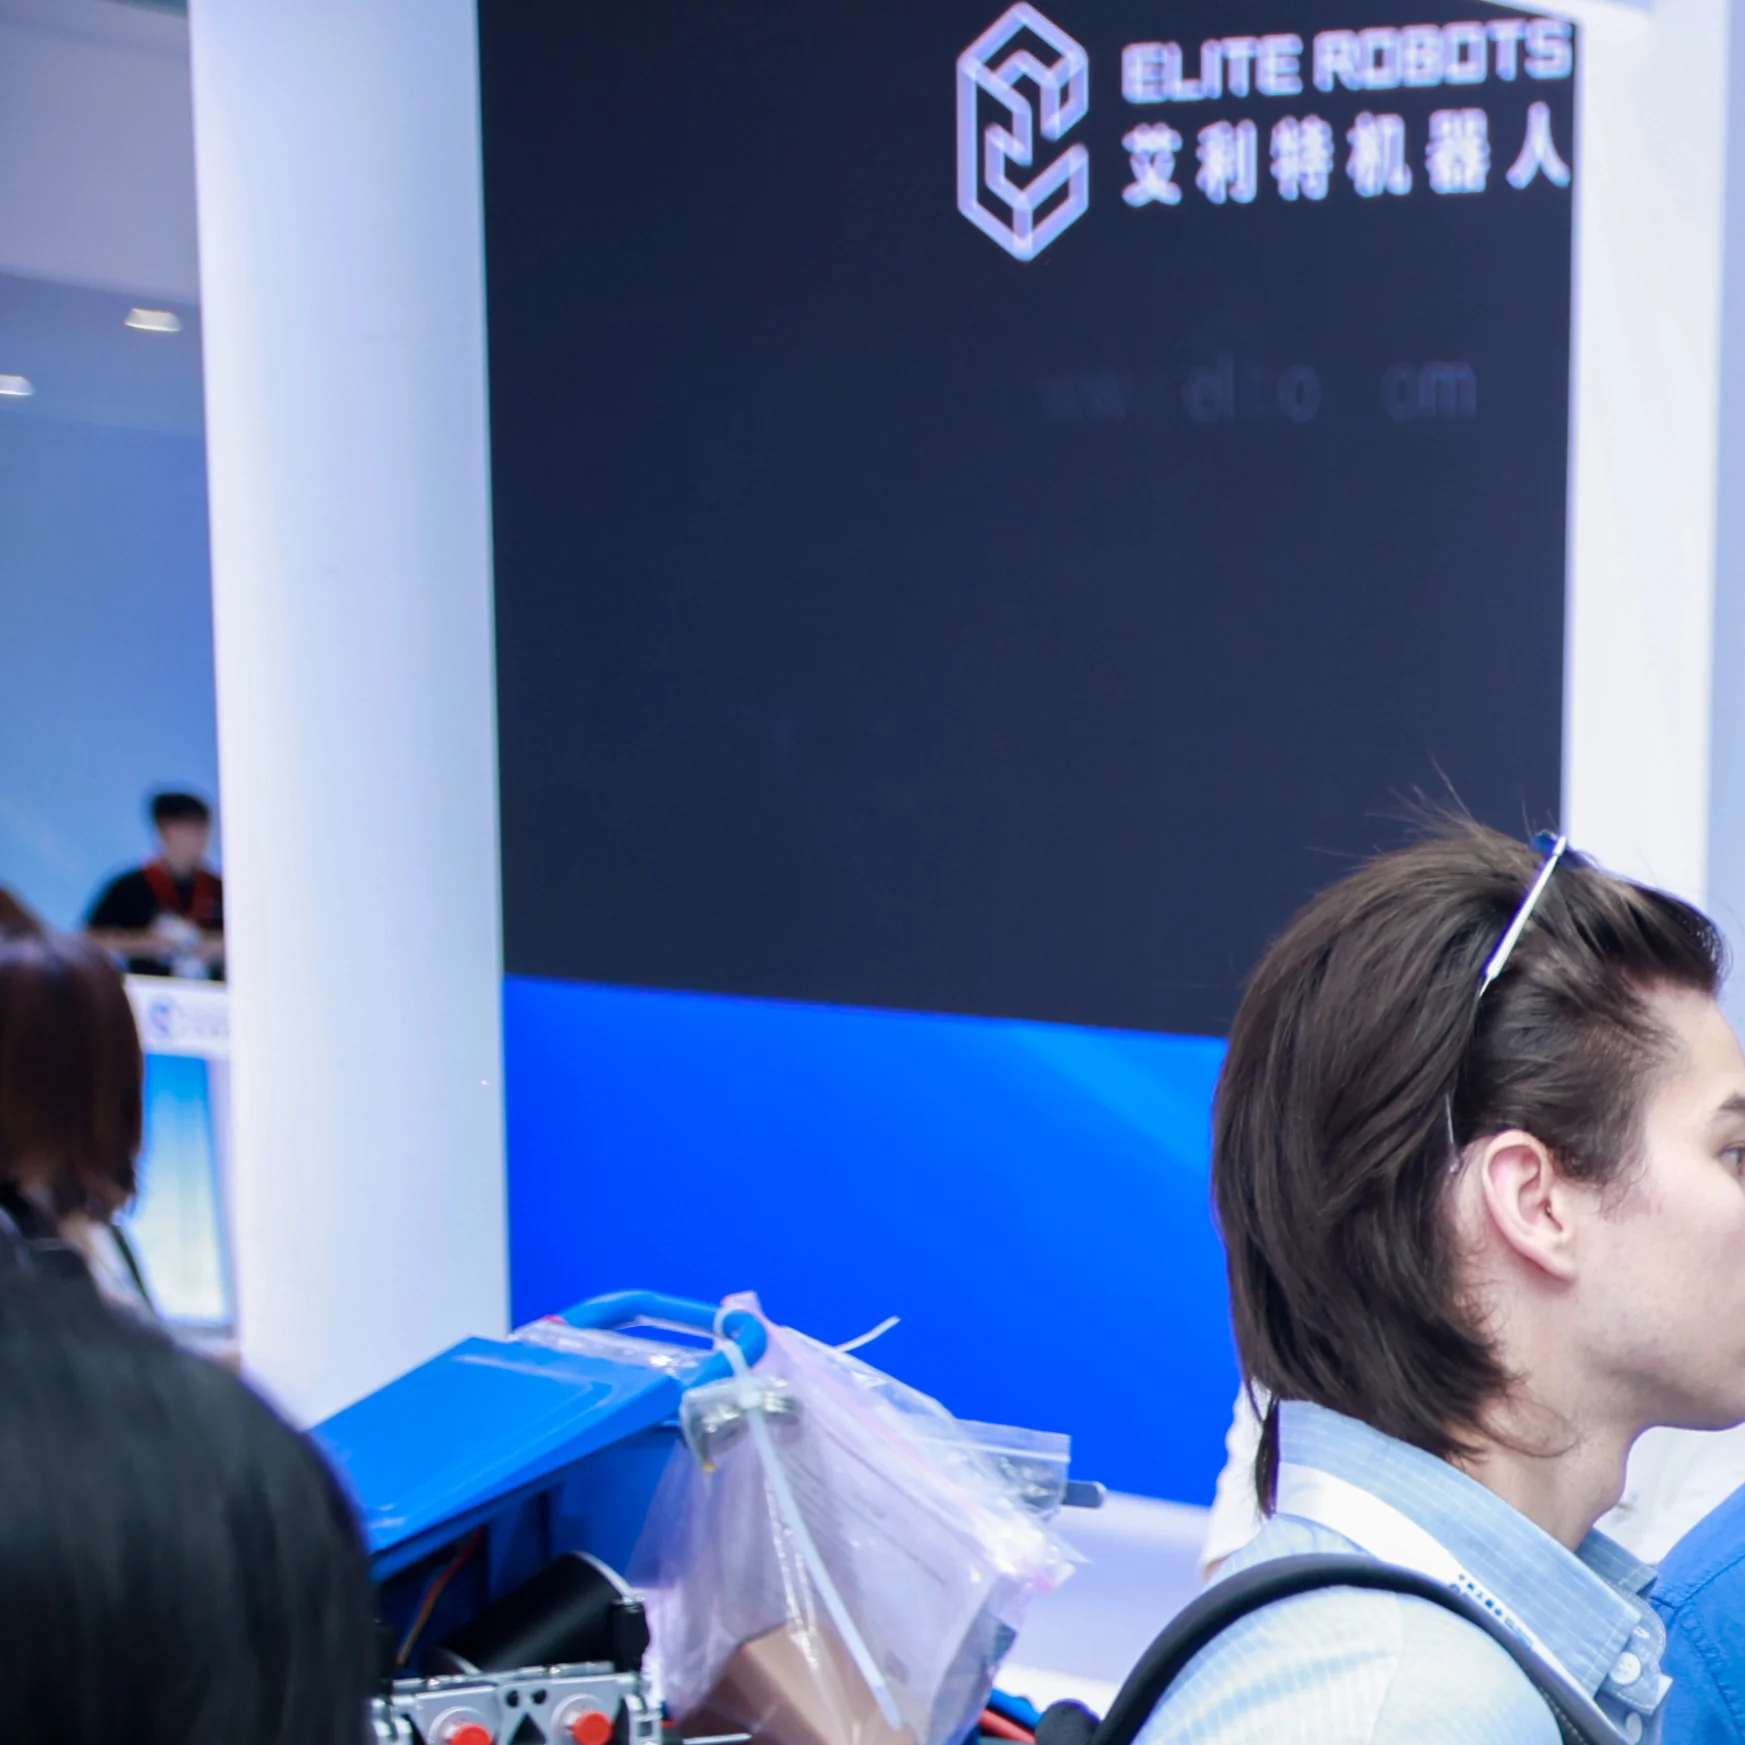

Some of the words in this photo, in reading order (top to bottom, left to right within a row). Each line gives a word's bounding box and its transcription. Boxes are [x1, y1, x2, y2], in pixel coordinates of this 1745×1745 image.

[1122, 34, 1302, 102] ELITE
[1313, 19, 1574, 91] ROBOTS
[1123, 102, 1571, 206] 艾利特机器人
